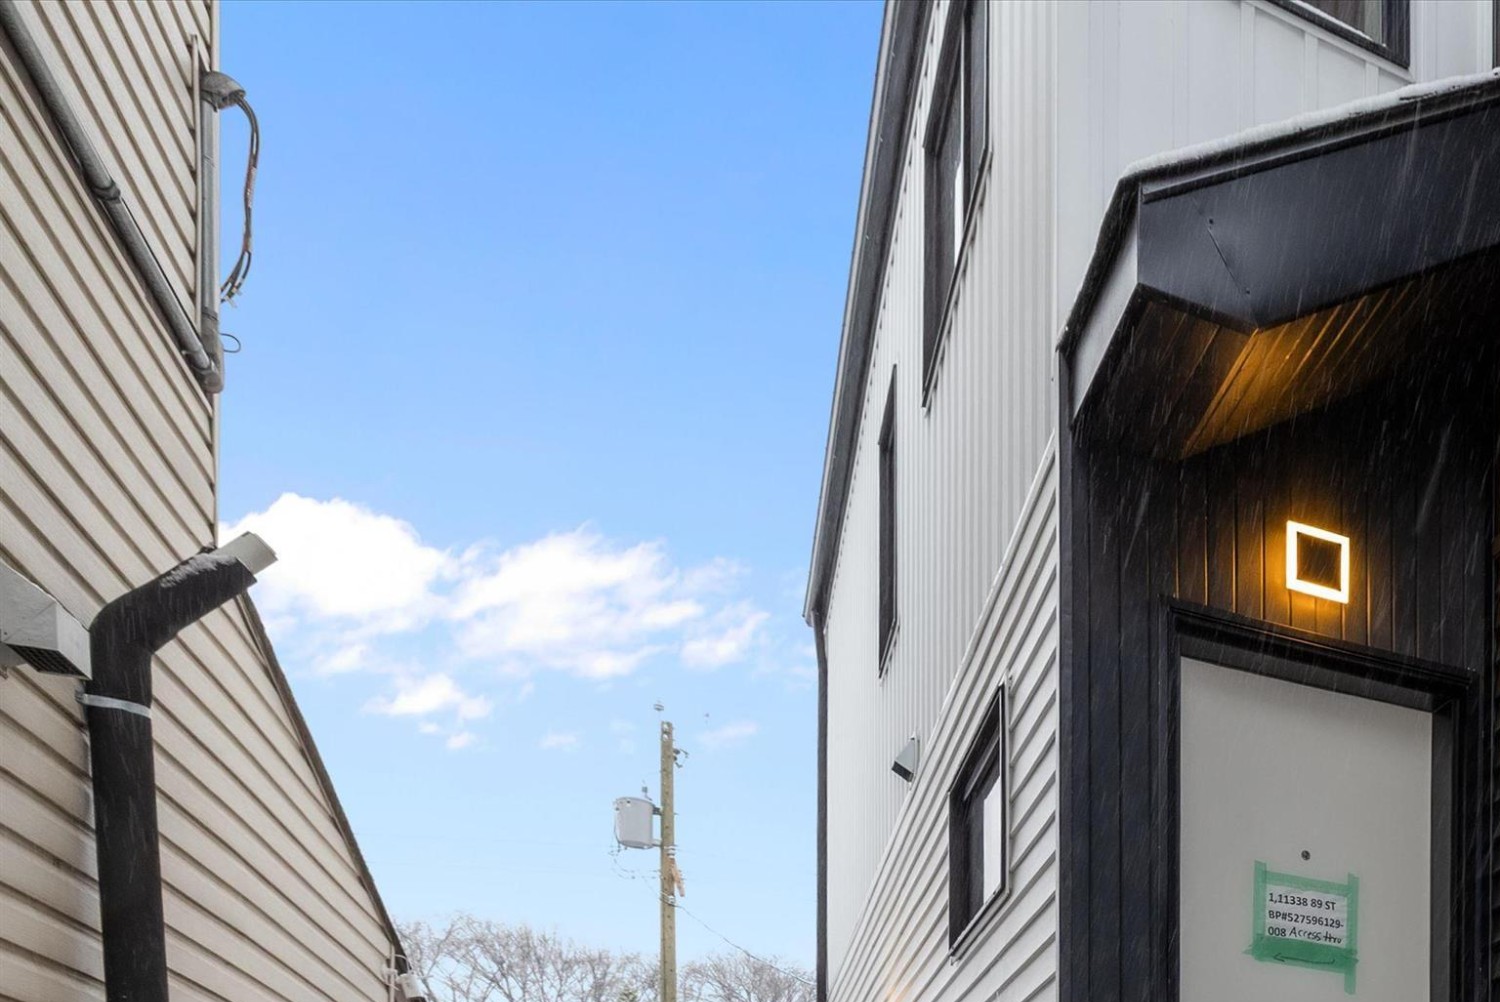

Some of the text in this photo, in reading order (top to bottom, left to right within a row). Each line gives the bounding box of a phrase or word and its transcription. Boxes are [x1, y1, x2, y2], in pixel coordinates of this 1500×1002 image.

[1269, 893, 1336, 910] 1,11338 89 ST
[1268, 926, 1286, 937] 008
[1289, 927, 1321, 941] Access
